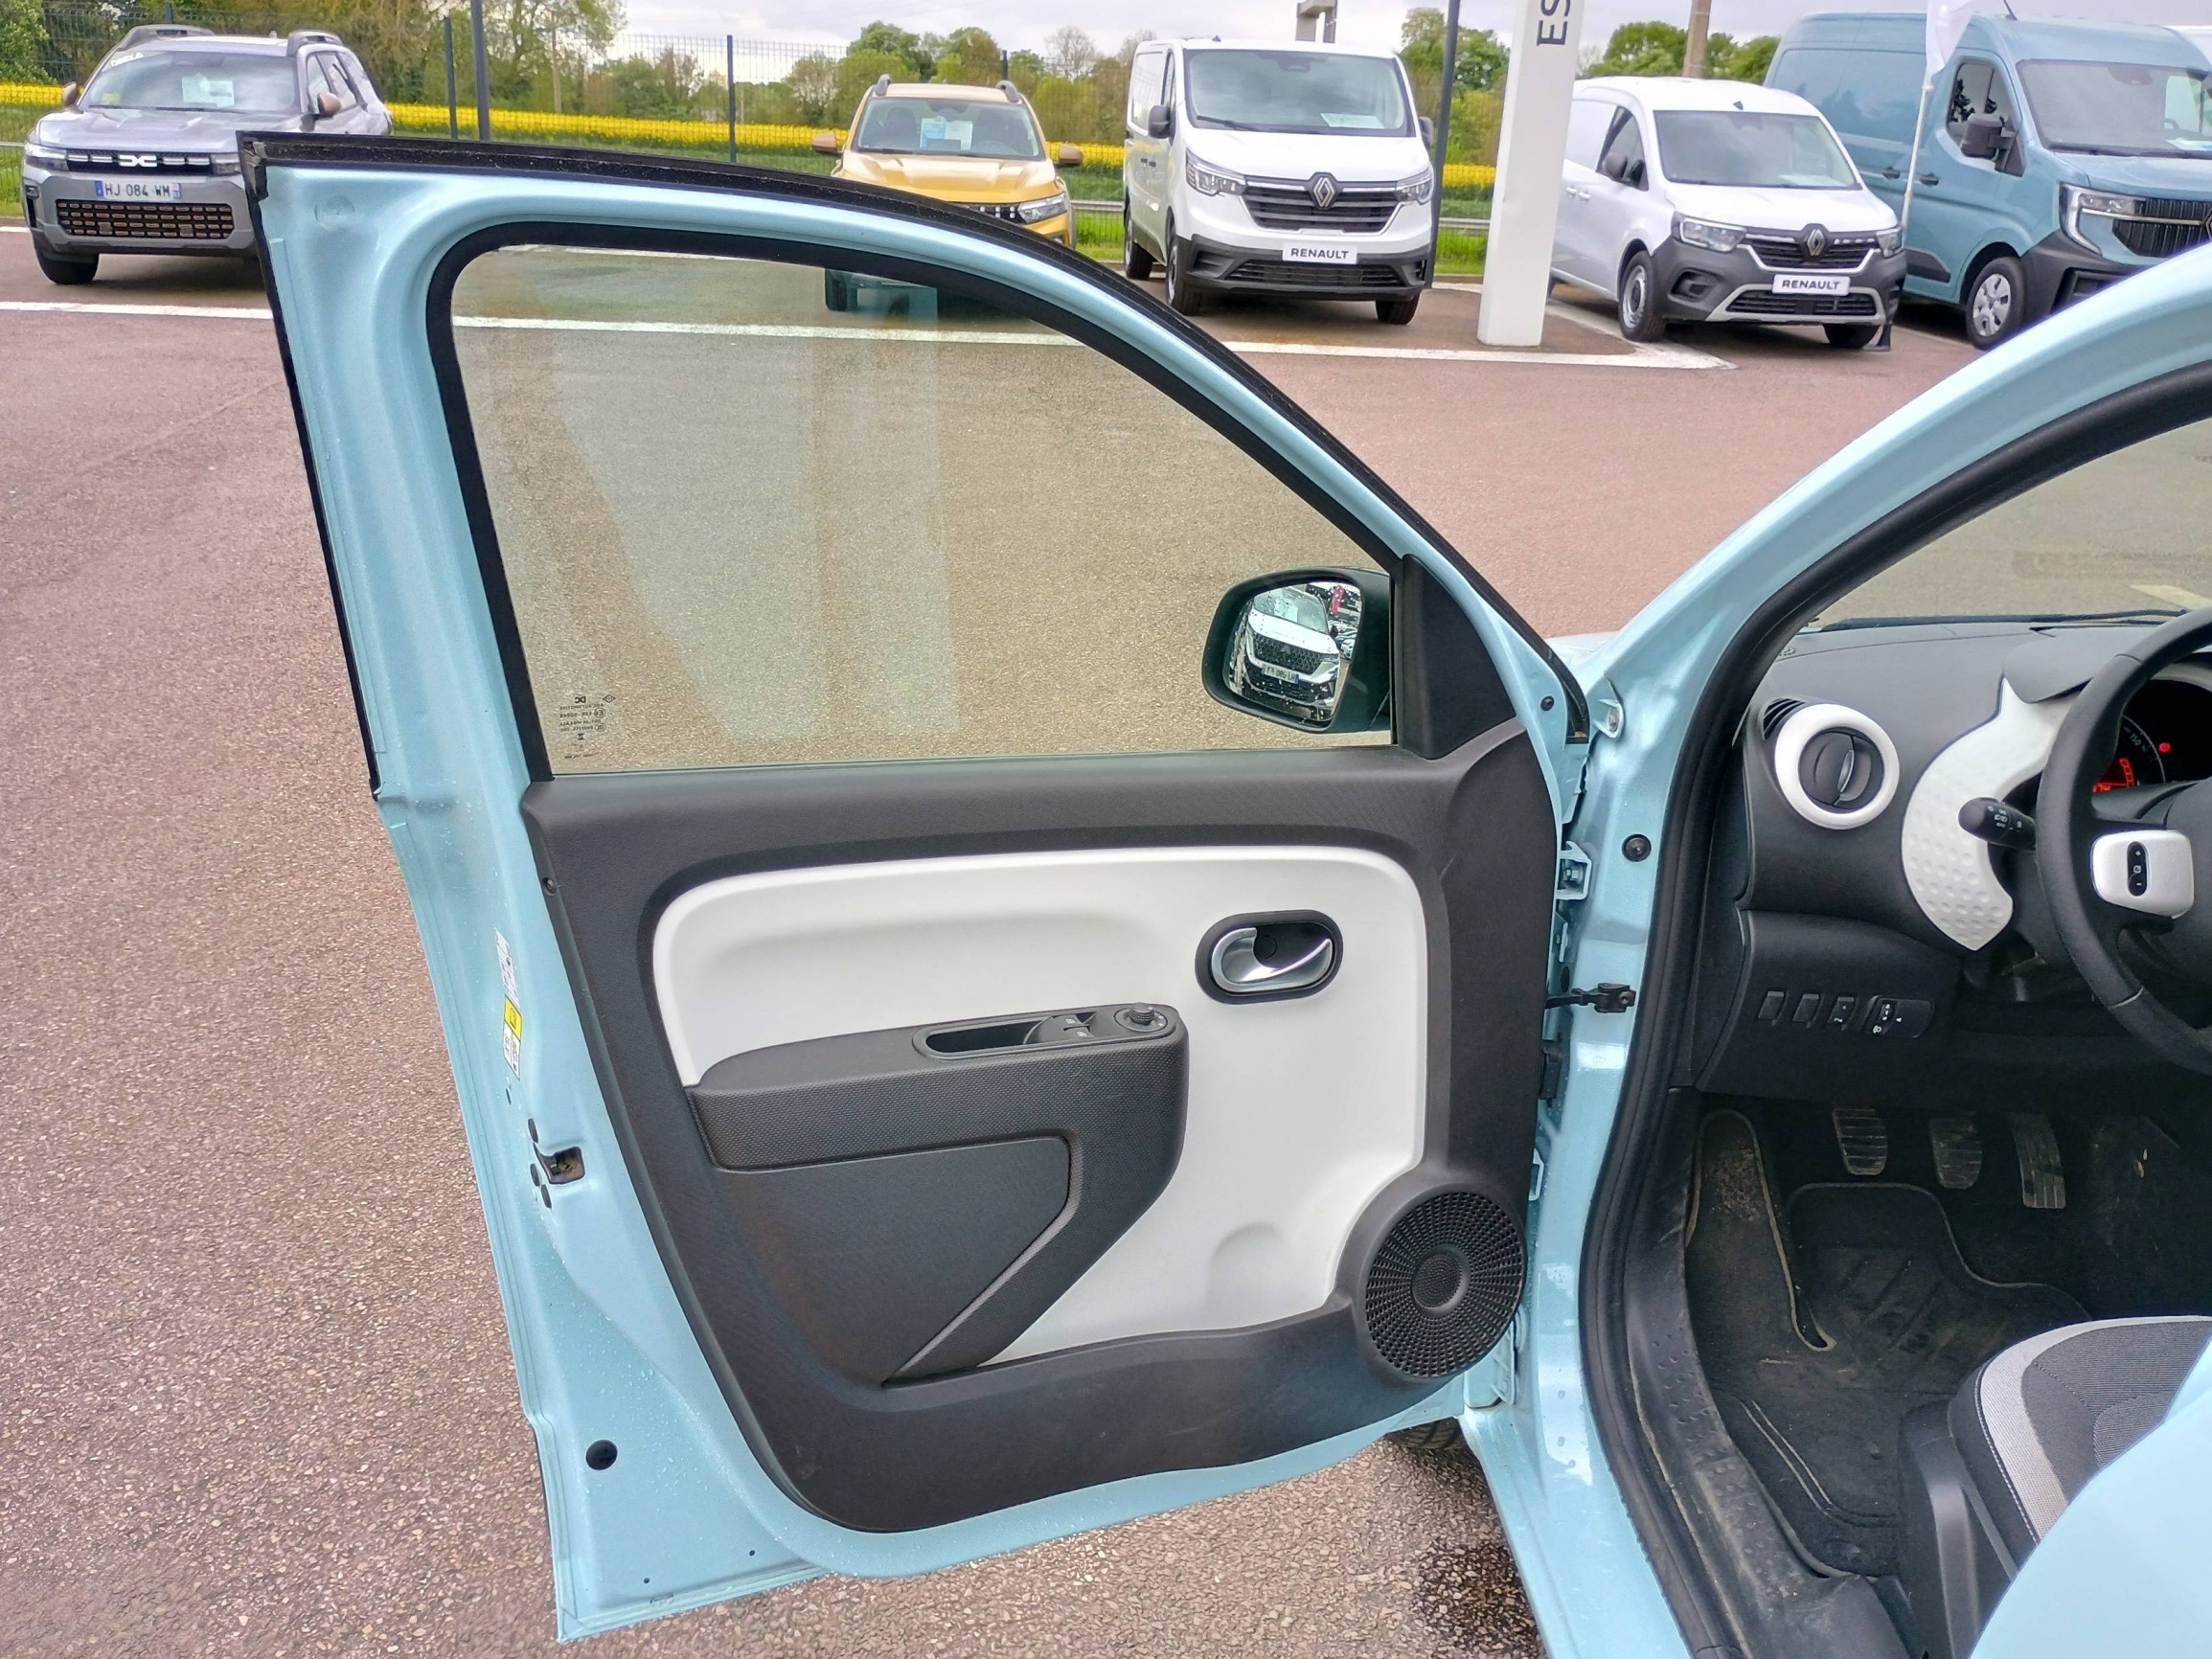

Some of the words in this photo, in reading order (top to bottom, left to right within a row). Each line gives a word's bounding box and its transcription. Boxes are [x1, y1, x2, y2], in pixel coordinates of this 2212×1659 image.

[1537, 0, 1571, 46] ES
[104, 183, 121, 196] HJ
[125, 184, 148, 196] 084
[1290, 248, 1349, 260] RENAULT
[1782, 280, 1841, 290] RENAULT
